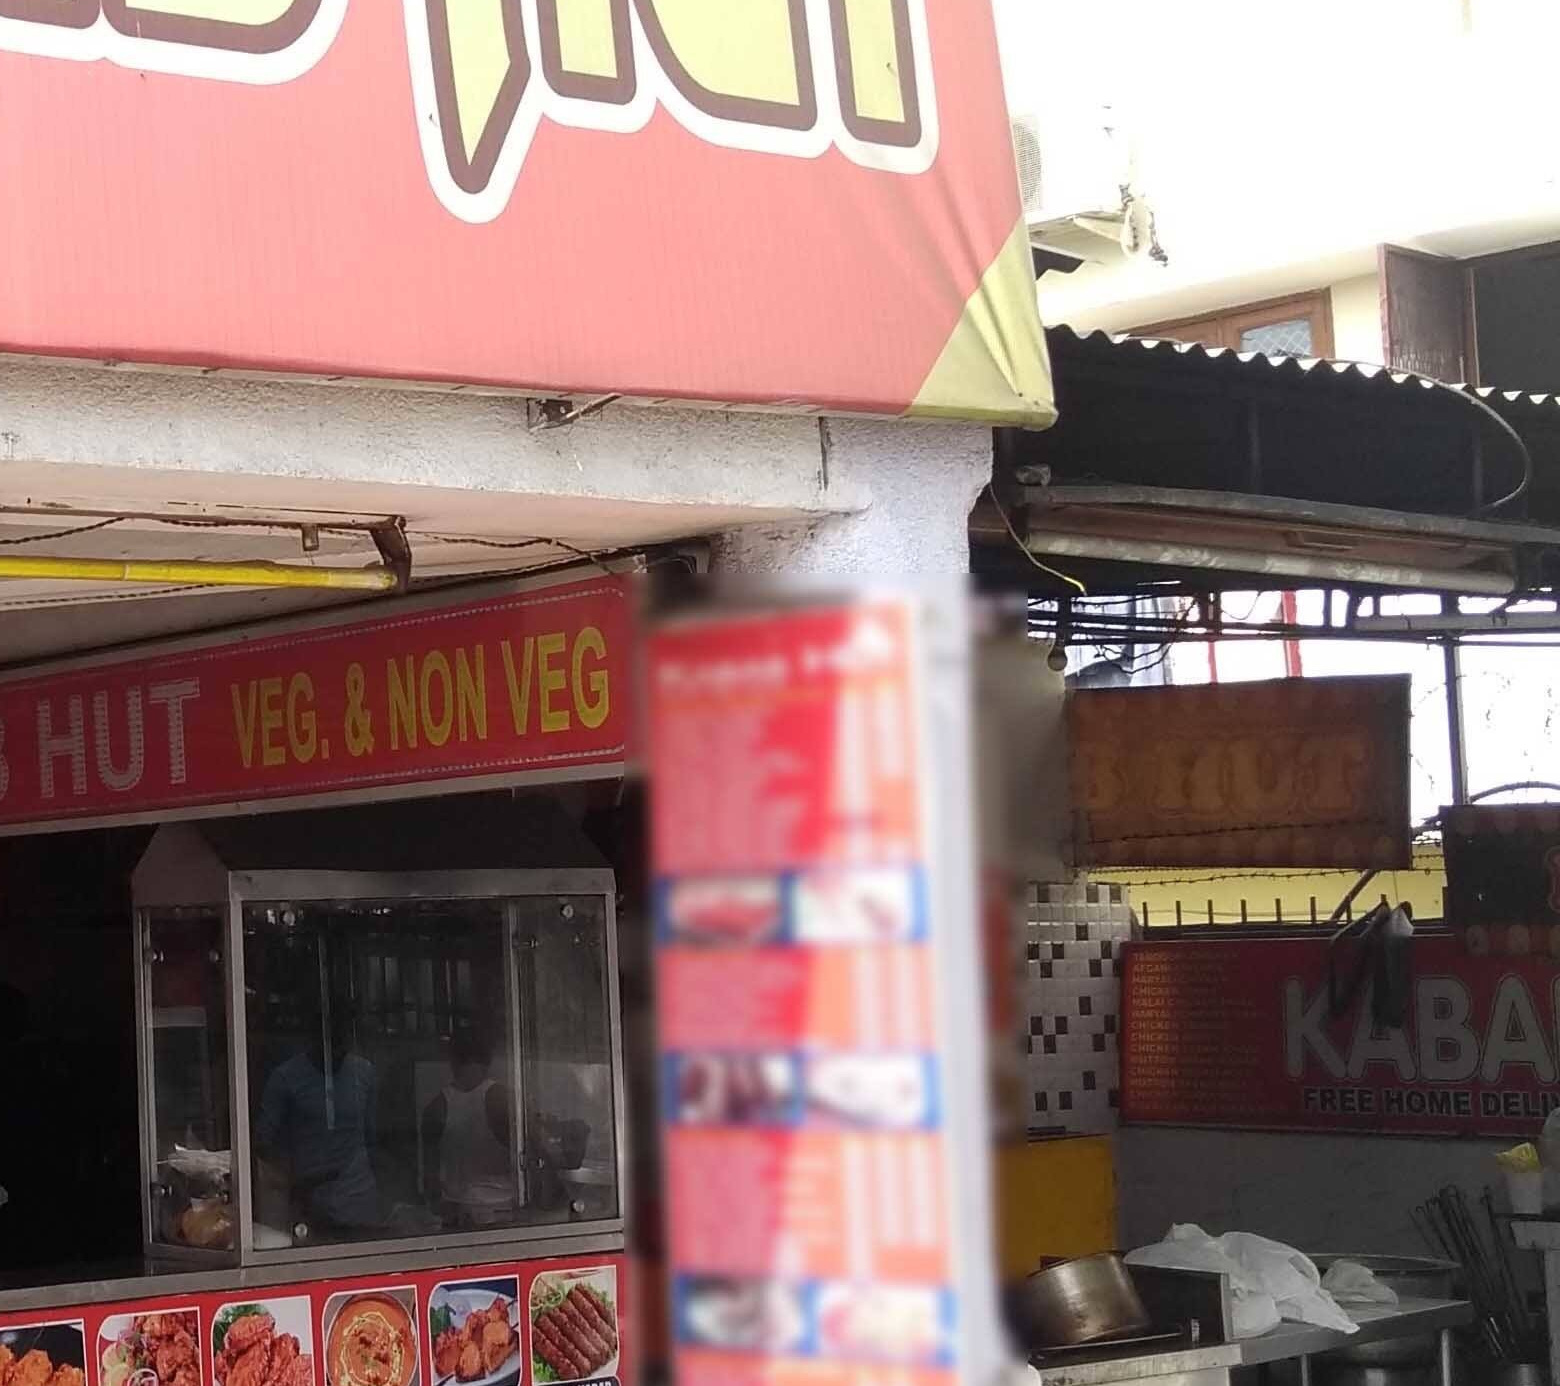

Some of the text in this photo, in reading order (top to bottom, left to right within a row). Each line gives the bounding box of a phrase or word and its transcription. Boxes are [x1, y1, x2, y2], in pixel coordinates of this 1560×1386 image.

[38, 677, 200, 798] HUT
[231, 671, 330, 769] VEG.
[344, 662, 375, 758] &
[386, 644, 488, 751] NON
[500, 625, 610, 736] VEG
[1282, 972, 1560, 1084] KABA
[1304, 1089, 1375, 1114] FREE
[1384, 1090, 1472, 1117] HOME
